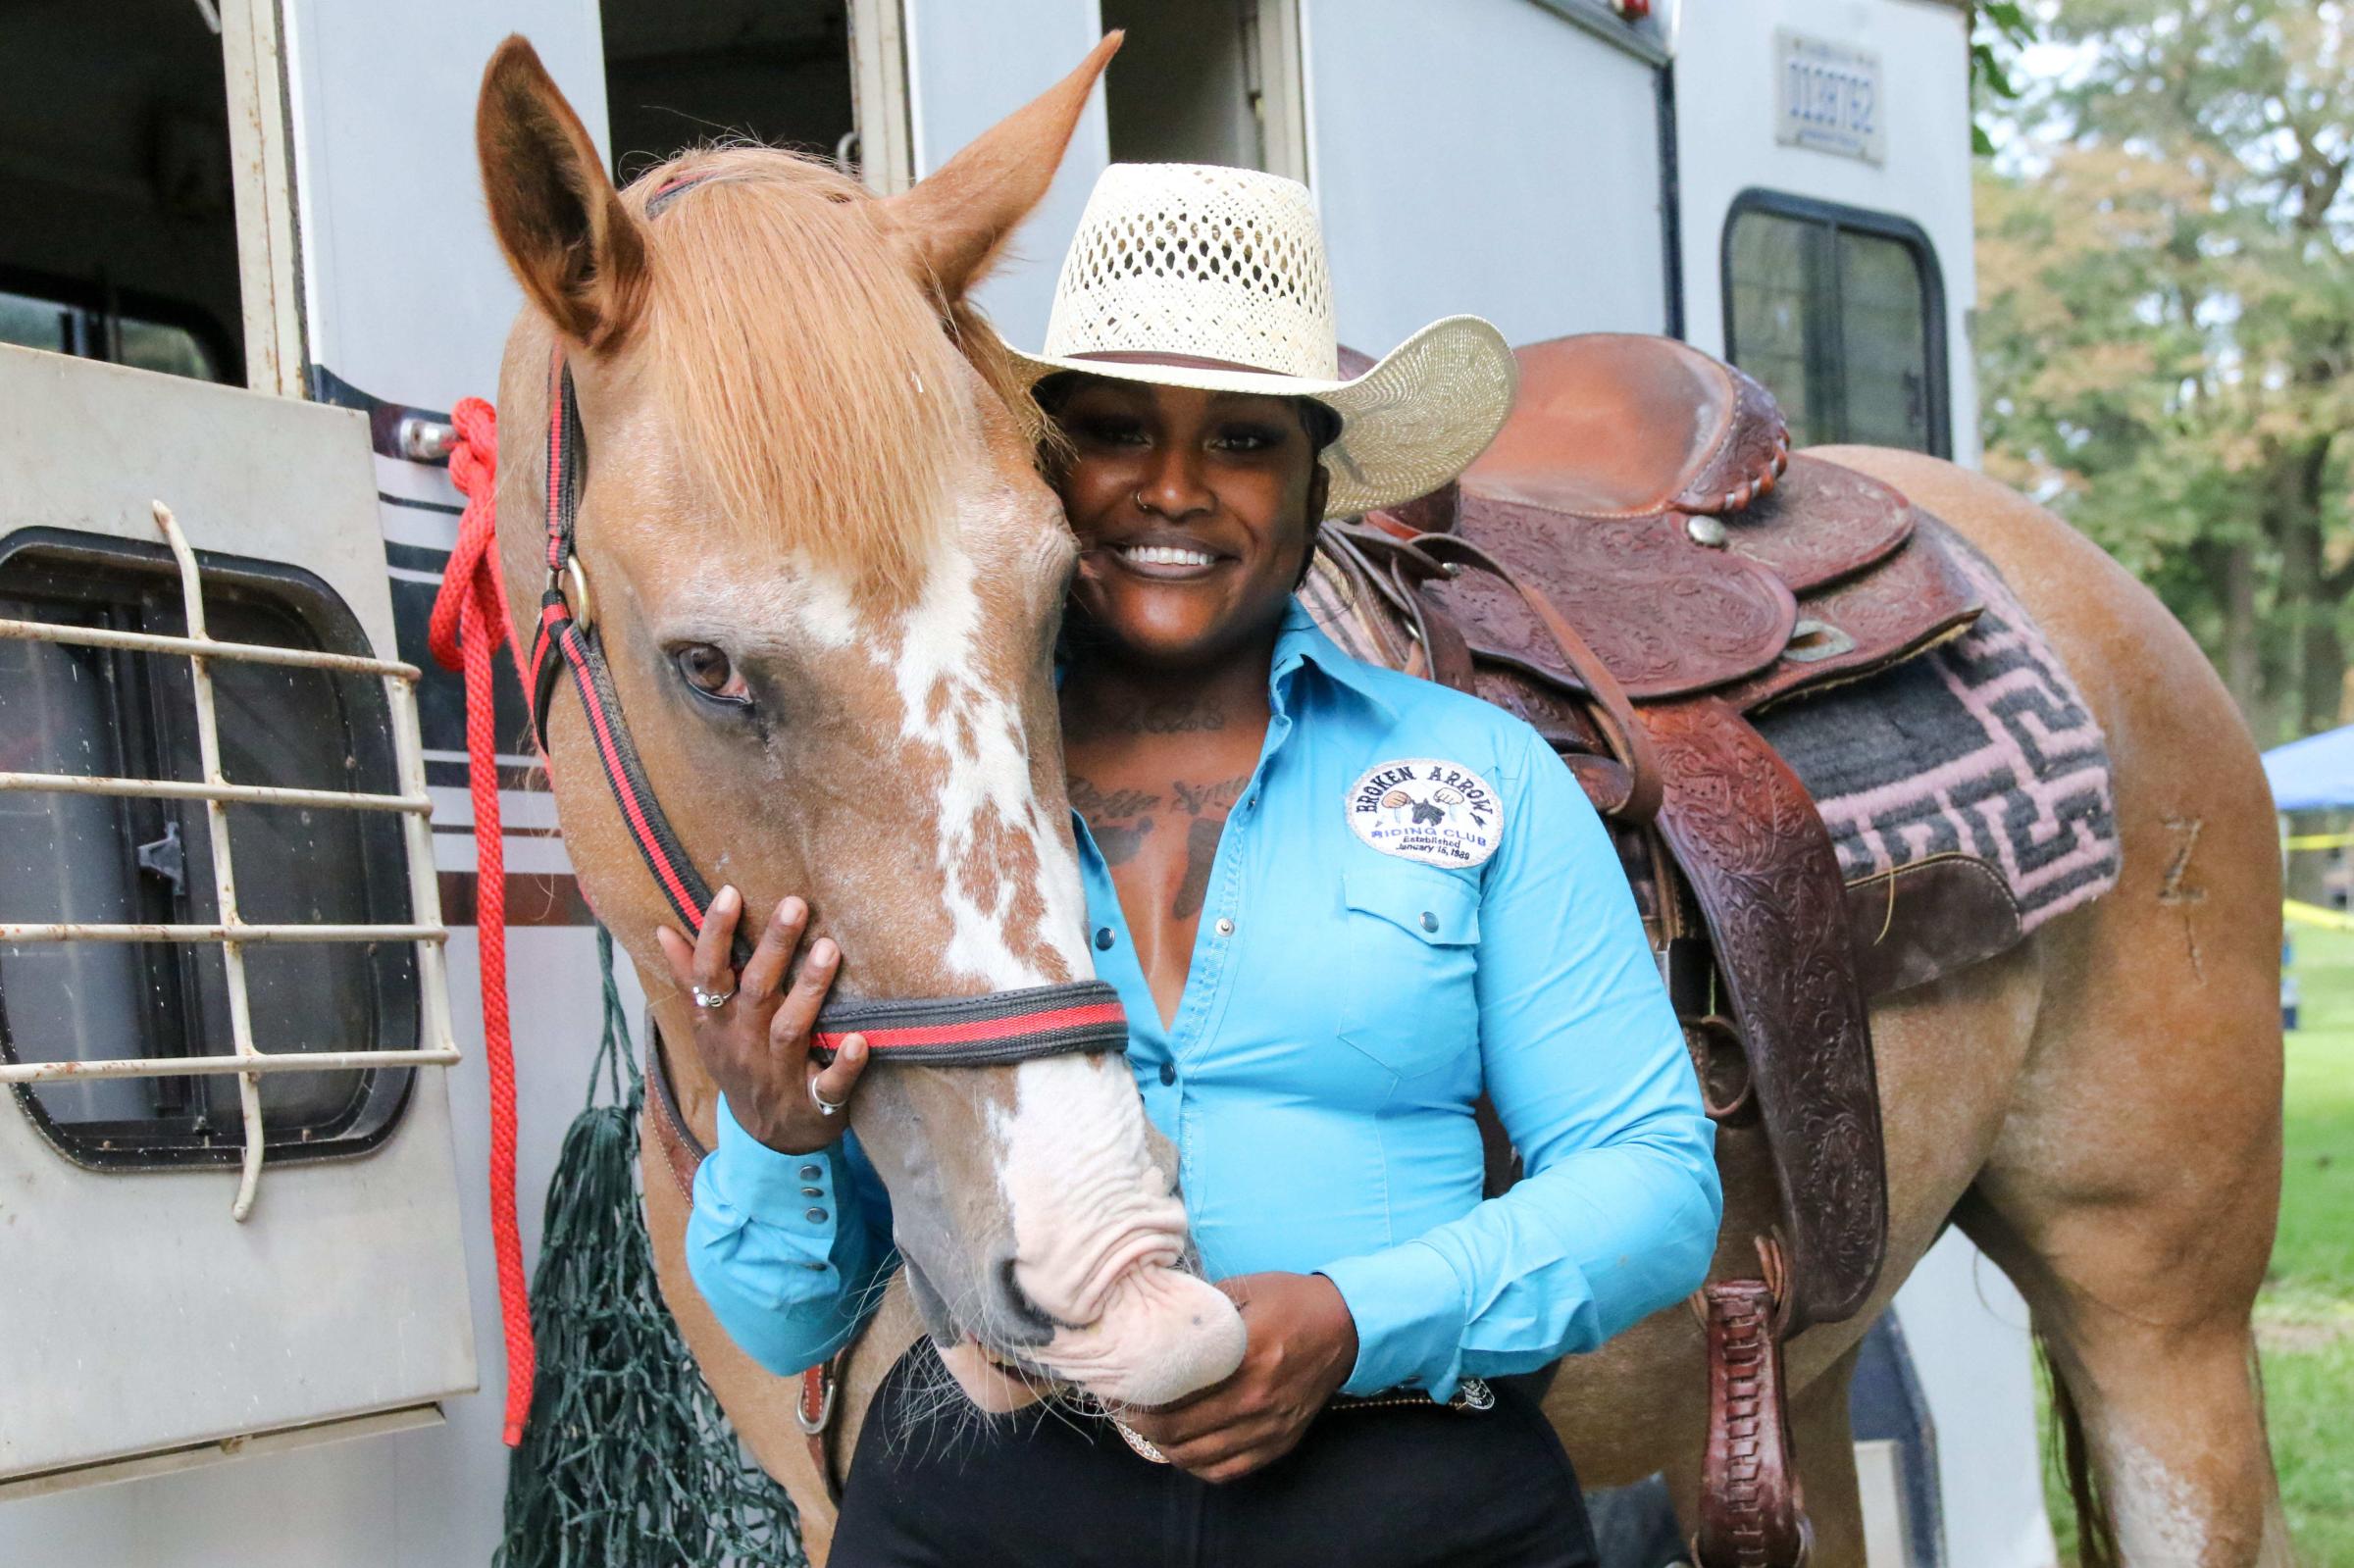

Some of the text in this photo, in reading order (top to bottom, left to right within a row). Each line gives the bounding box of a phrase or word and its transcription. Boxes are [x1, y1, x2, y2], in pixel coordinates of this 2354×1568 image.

[1356, 766, 1493, 814] BROKEN ARROW
[1371, 827, 1487, 847] RIDING CLUB
[1403, 835, 1460, 848] Established
[1396, 842, 1435, 854] January
[1451, 848, 1470, 861] 1989
